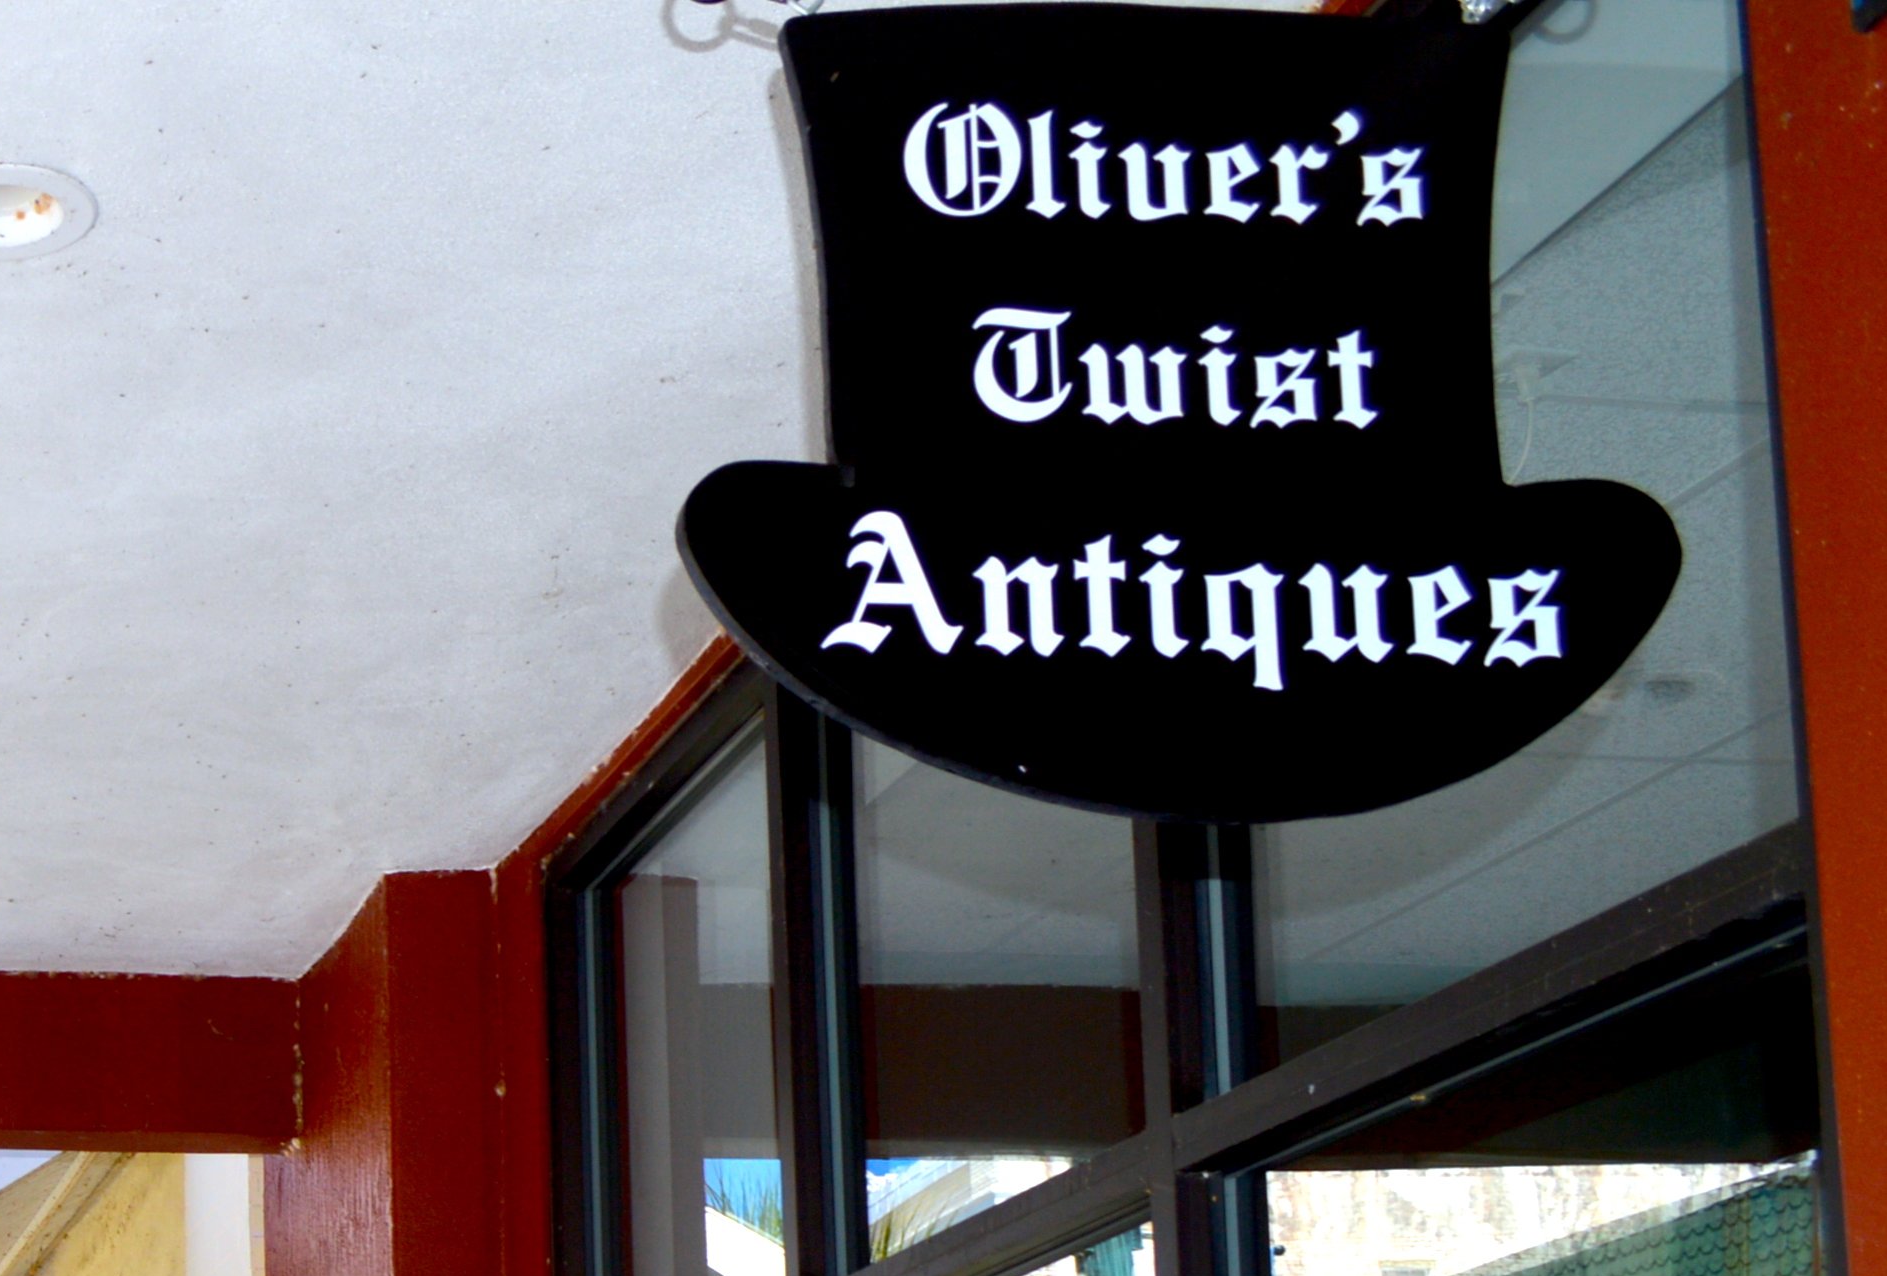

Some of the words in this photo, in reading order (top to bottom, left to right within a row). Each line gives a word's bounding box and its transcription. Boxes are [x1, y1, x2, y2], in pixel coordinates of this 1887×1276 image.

[904, 102, 1426, 227] Oliver's
[972, 307, 1380, 430] Twist
[820, 510, 1564, 691] Antiques
